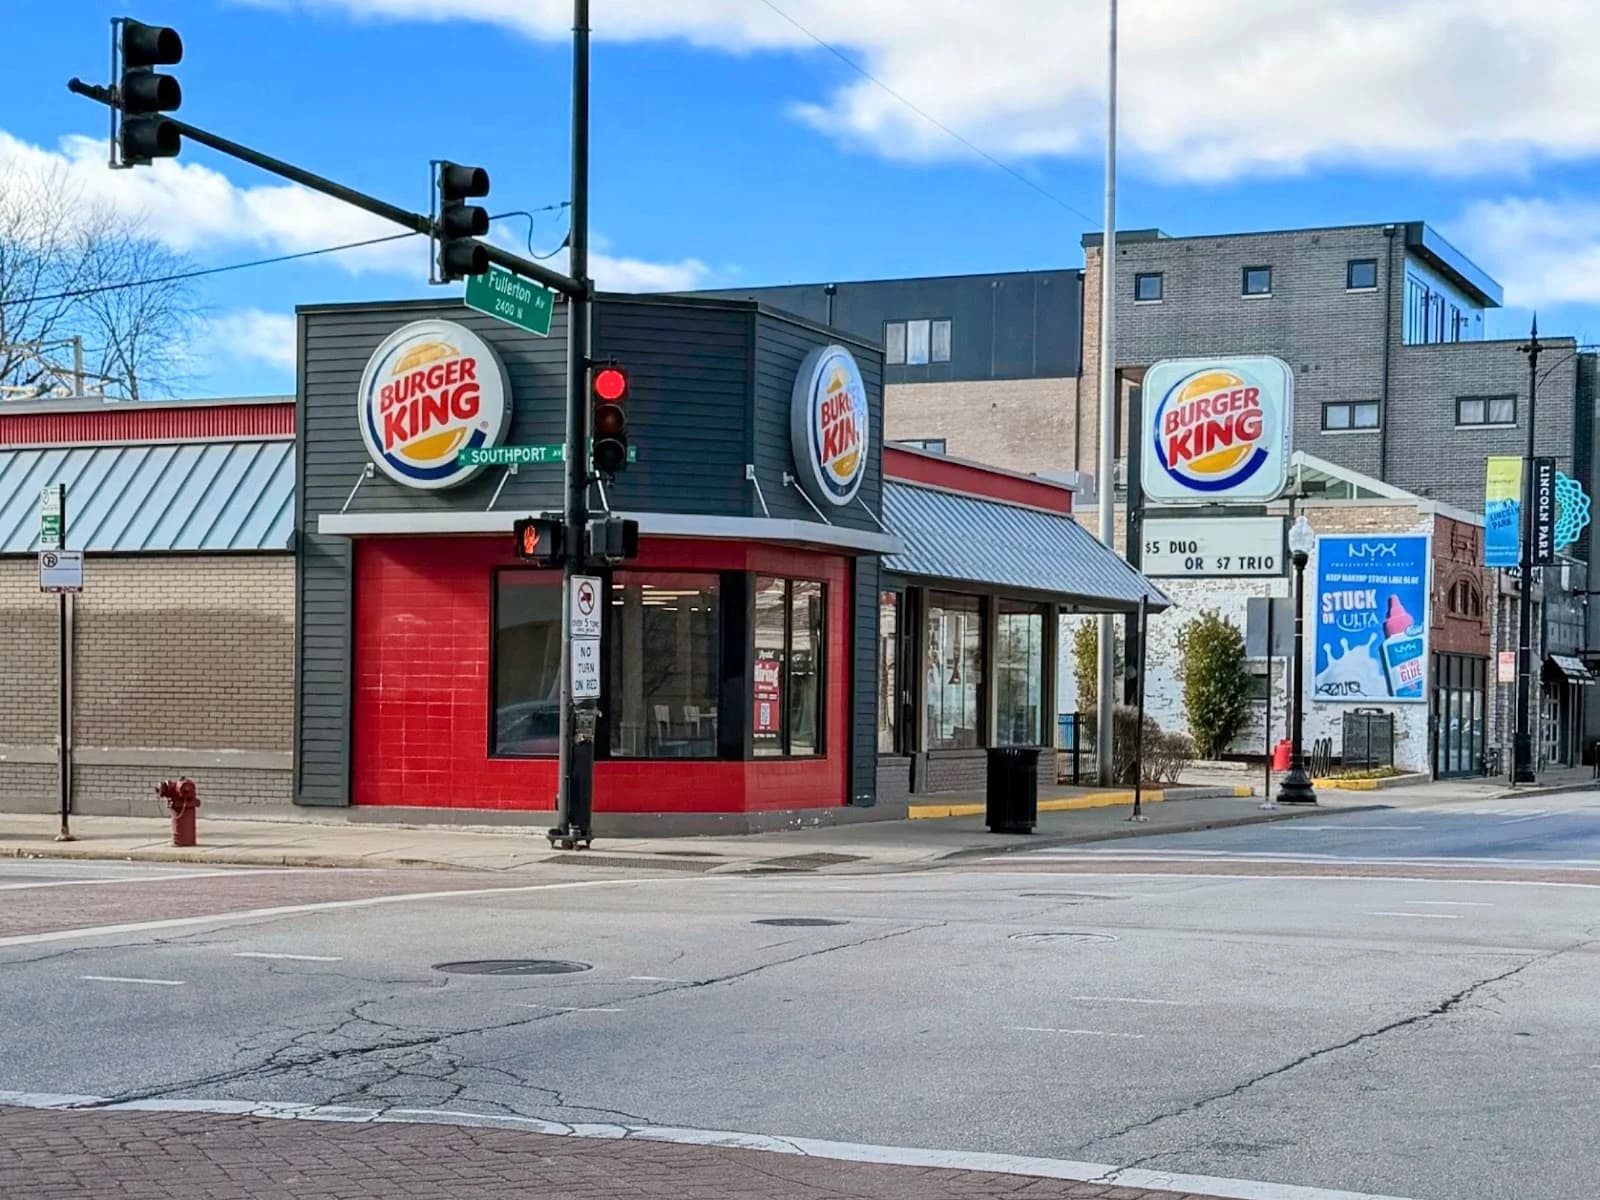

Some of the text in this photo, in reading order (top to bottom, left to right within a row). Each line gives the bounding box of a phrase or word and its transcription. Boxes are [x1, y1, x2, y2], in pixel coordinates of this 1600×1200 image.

[488, 270, 532, 305] Fullerton
[495, 297, 515, 316] 2400
[379, 357, 477, 414] BURGER
[383, 382, 481, 451] KING
[1164, 386, 1260, 437] BURGER
[821, 413, 860, 466] KIN
[1167, 408, 1263, 469] KING
[471, 447, 547, 464] SOUTHPORT
[1537, 465, 1550, 559] LINCOLN PARK
[1145, 540, 1198, 555] $5 DUO
[1348, 543, 1397, 561] NYX
[1184, 557, 1275, 570] OR $7 TRIO
[1321, 589, 1378, 612] STUCK
[584, 618, 589, 628] 5
[1322, 610, 1336, 625] ON
[580, 646, 592, 658] NO
[578, 663, 595, 674] TURN
[1400, 664, 1422, 682] GLUE
[575, 679, 598, 691] ON RED
